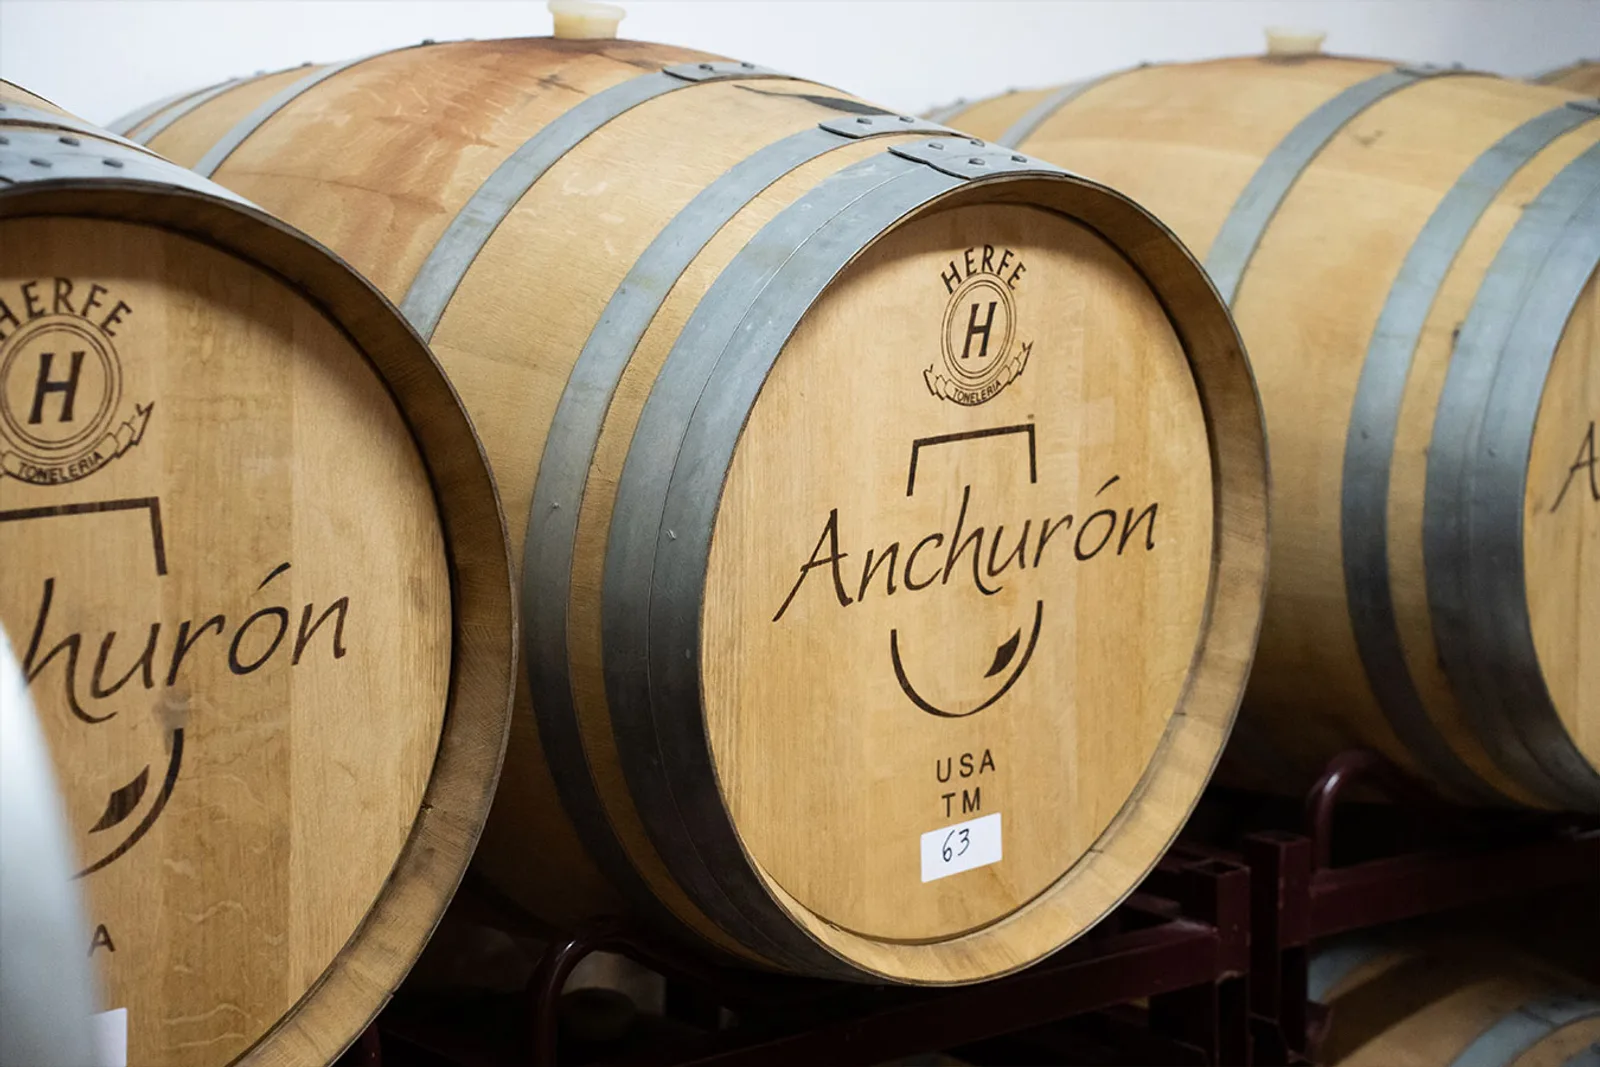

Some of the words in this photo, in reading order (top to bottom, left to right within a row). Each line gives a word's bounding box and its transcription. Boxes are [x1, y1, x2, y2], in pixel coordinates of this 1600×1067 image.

[940, 244, 1026, 295] HERFE
[0, 276, 133, 341] HERFE
[961, 301, 998, 359] H
[28, 351, 86, 425] H
[952, 380, 1001, 403] TONELERIA
[18, 451, 104, 483] TONELERIA
[771, 475, 1159, 623] Anchurón
[936, 748, 996, 783] USA
[941, 786, 981, 818] TM
[942, 828, 970, 863] 63
